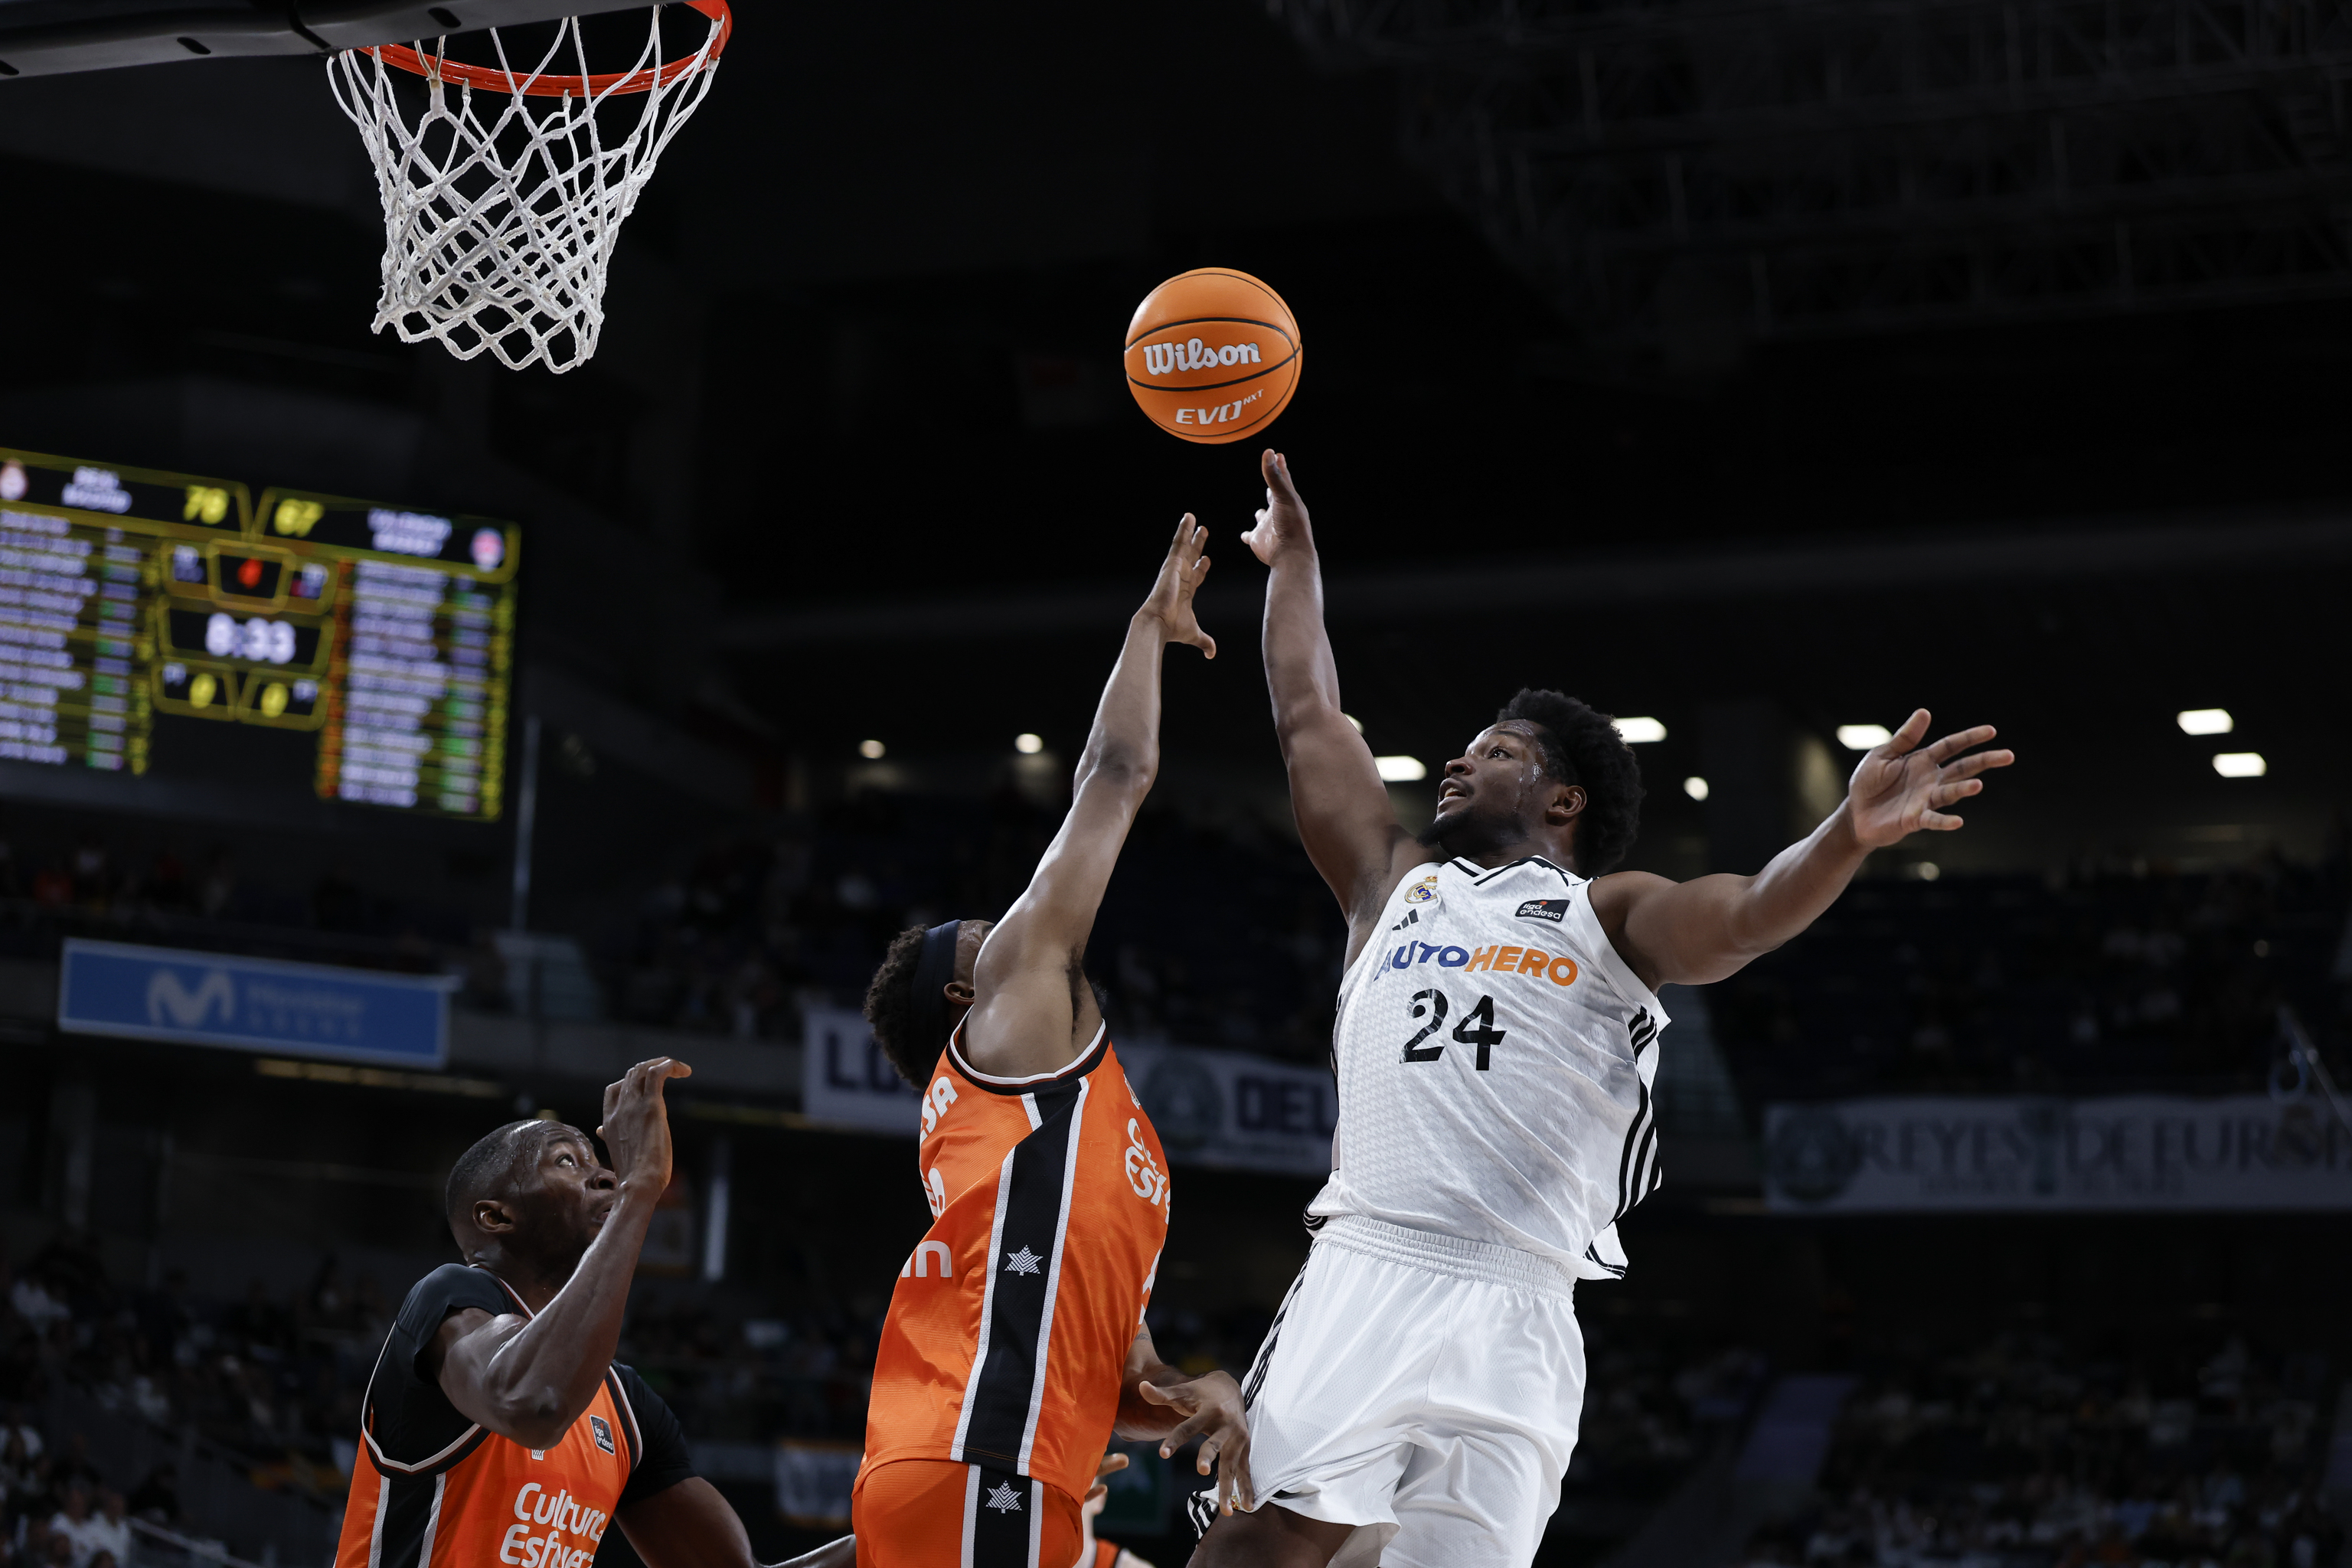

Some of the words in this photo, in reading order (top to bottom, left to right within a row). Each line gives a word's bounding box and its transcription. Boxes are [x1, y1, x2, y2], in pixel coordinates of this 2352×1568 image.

[1143, 338, 1262, 375] Wilson
[1520, 909, 1562, 920] endesa
[1399, 988, 1507, 1070] 24
